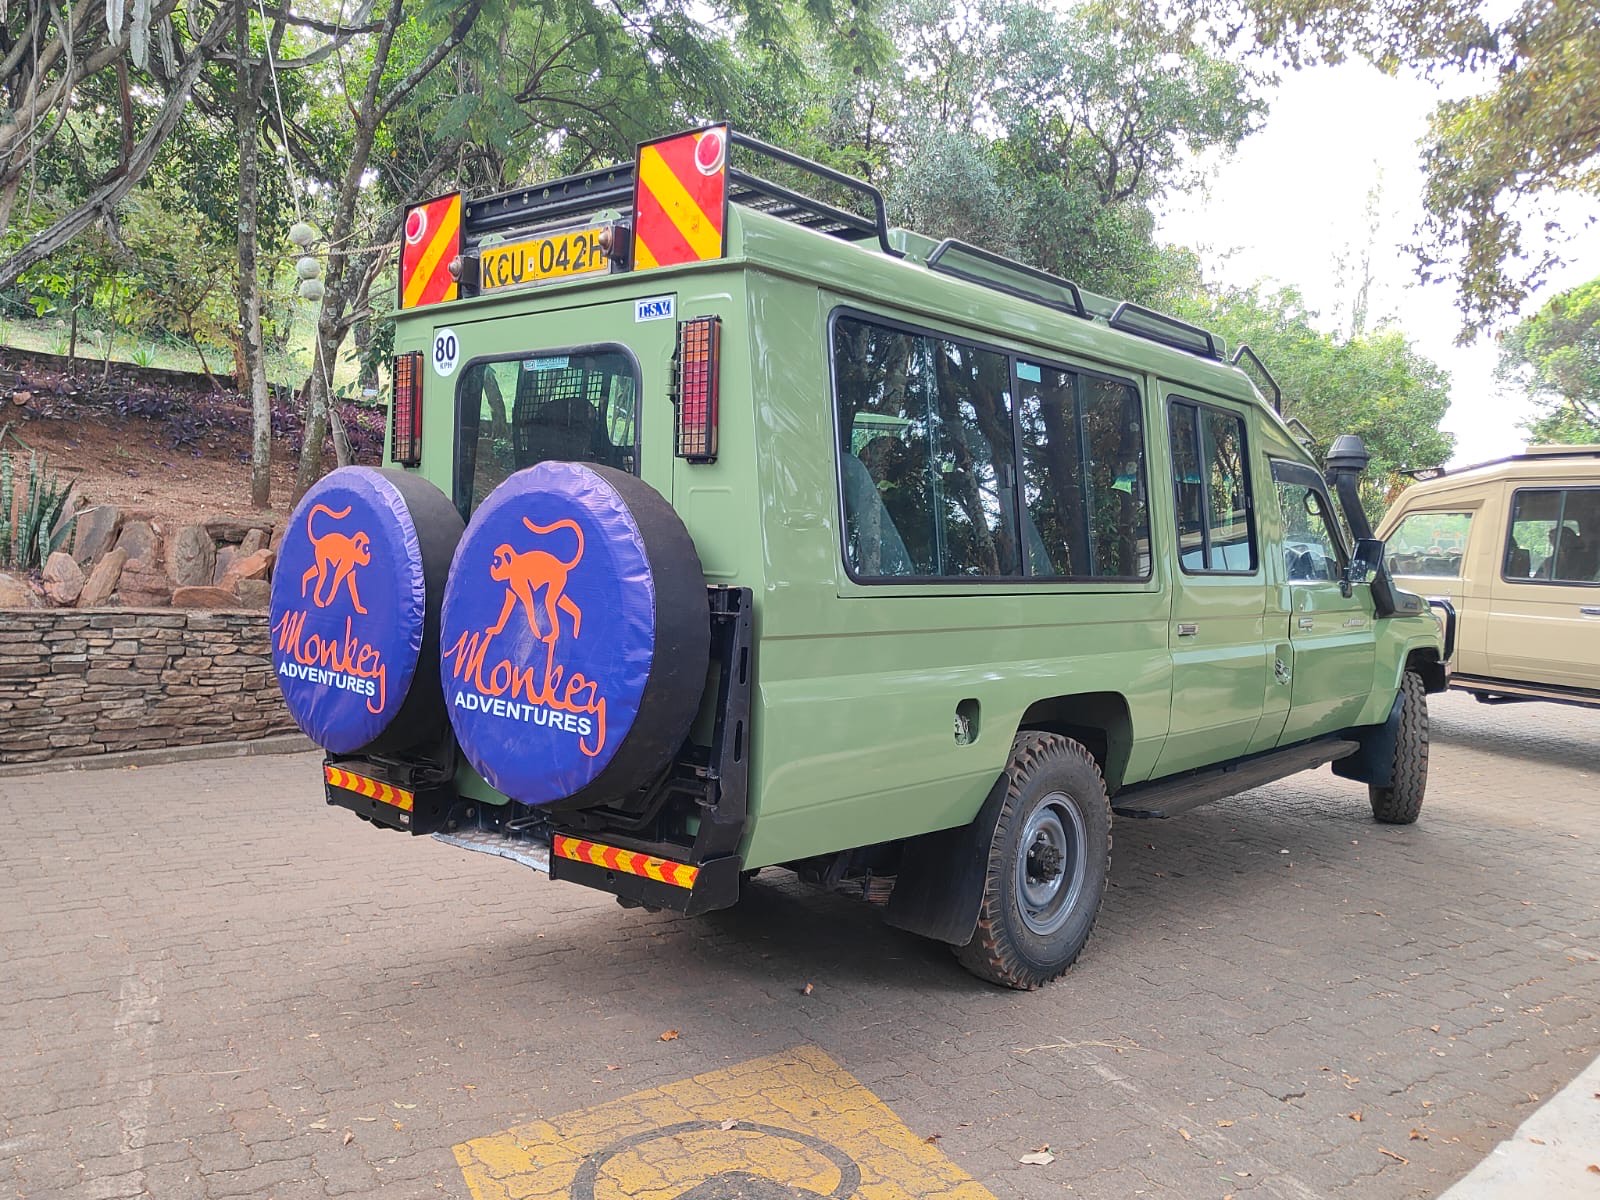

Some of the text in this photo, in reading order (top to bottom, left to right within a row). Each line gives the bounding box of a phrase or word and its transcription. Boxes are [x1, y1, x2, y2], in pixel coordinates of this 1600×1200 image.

[482, 233, 603, 289] KCU 042H
[436, 335, 456, 362] 80
[440, 361, 453, 370] KPH
[272, 609, 387, 715] Monkey
[278, 660, 376, 697] ADVENTURES
[443, 629, 606, 757] Monkey
[453, 690, 592, 737] ADVENTURES
